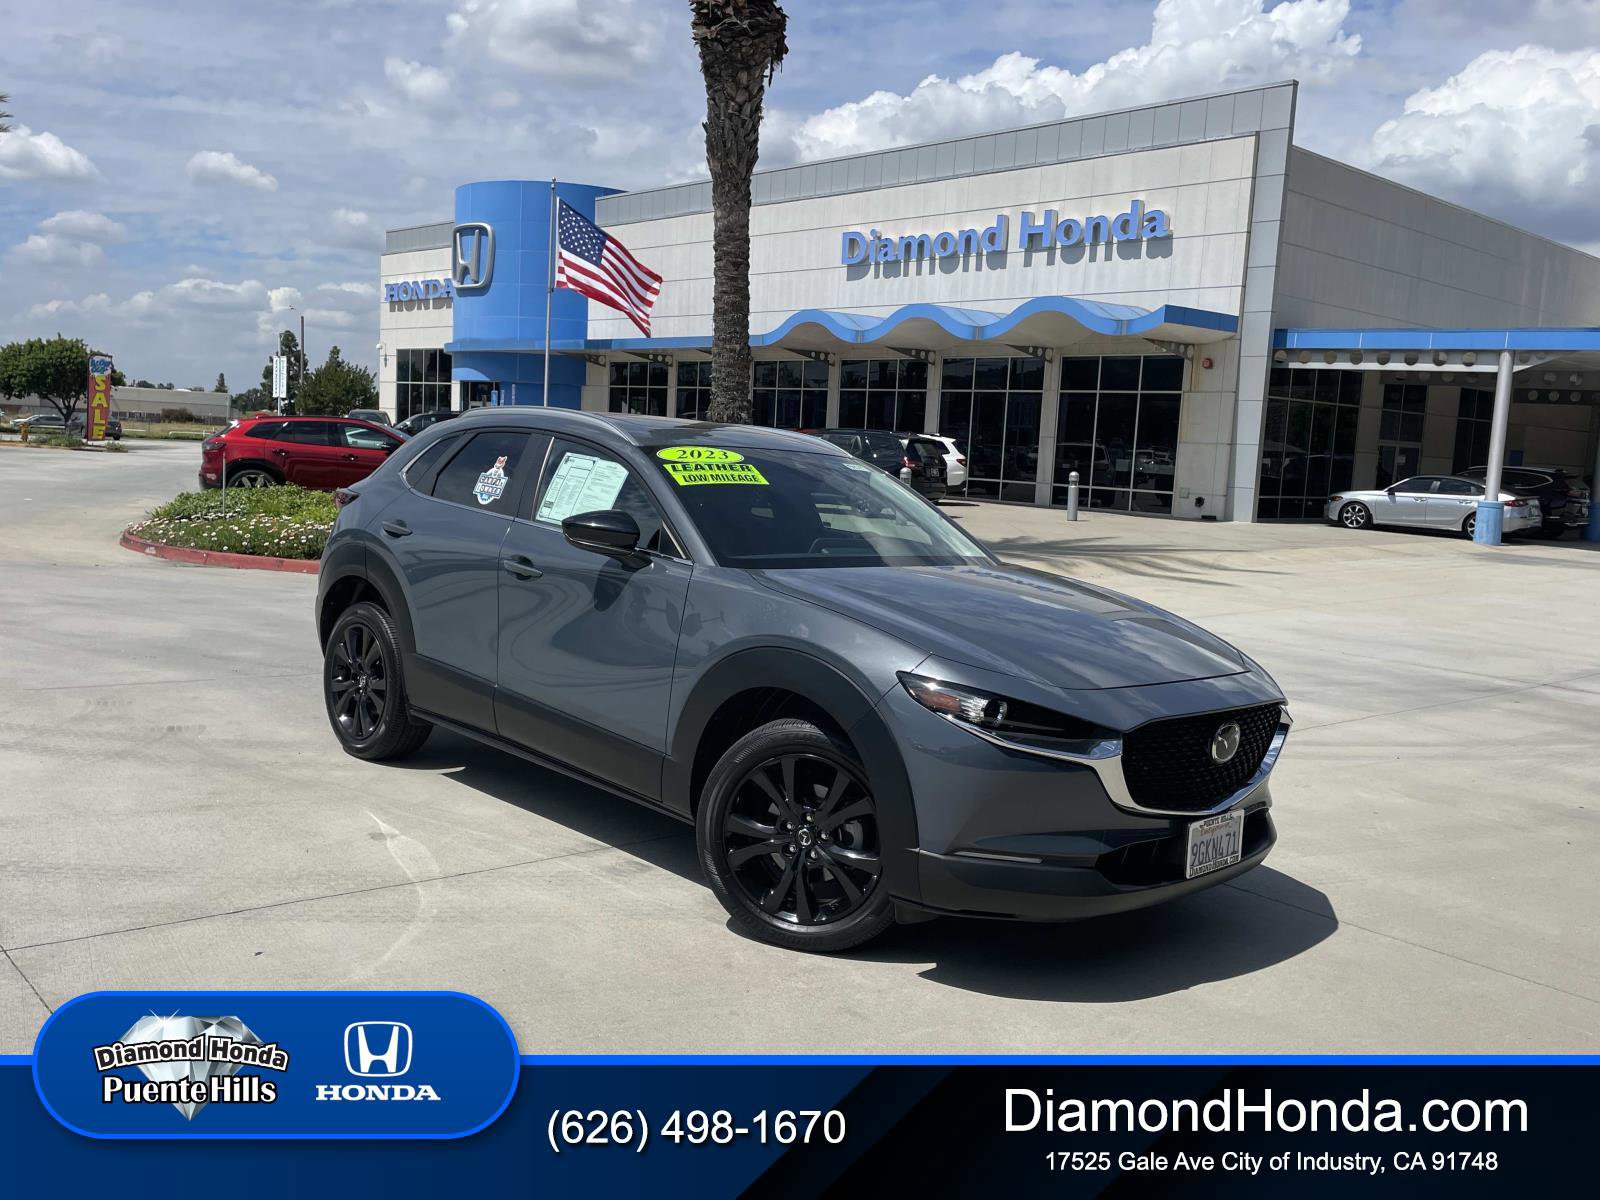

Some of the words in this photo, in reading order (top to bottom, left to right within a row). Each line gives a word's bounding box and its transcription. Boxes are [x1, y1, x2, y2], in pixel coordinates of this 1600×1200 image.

[841, 214, 1009, 266] Diamond
[1018, 199, 1170, 250] Honda
[384, 278, 454, 303] HONDA
[91, 375, 108, 440] SALE
[676, 449, 729, 460] 2023
[670, 463, 752, 472] LEATHER
[682, 473, 707, 483] LOW
[709, 473, 760, 483] MILEAGE
[1191, 831, 1236, 866] 9GKN471
